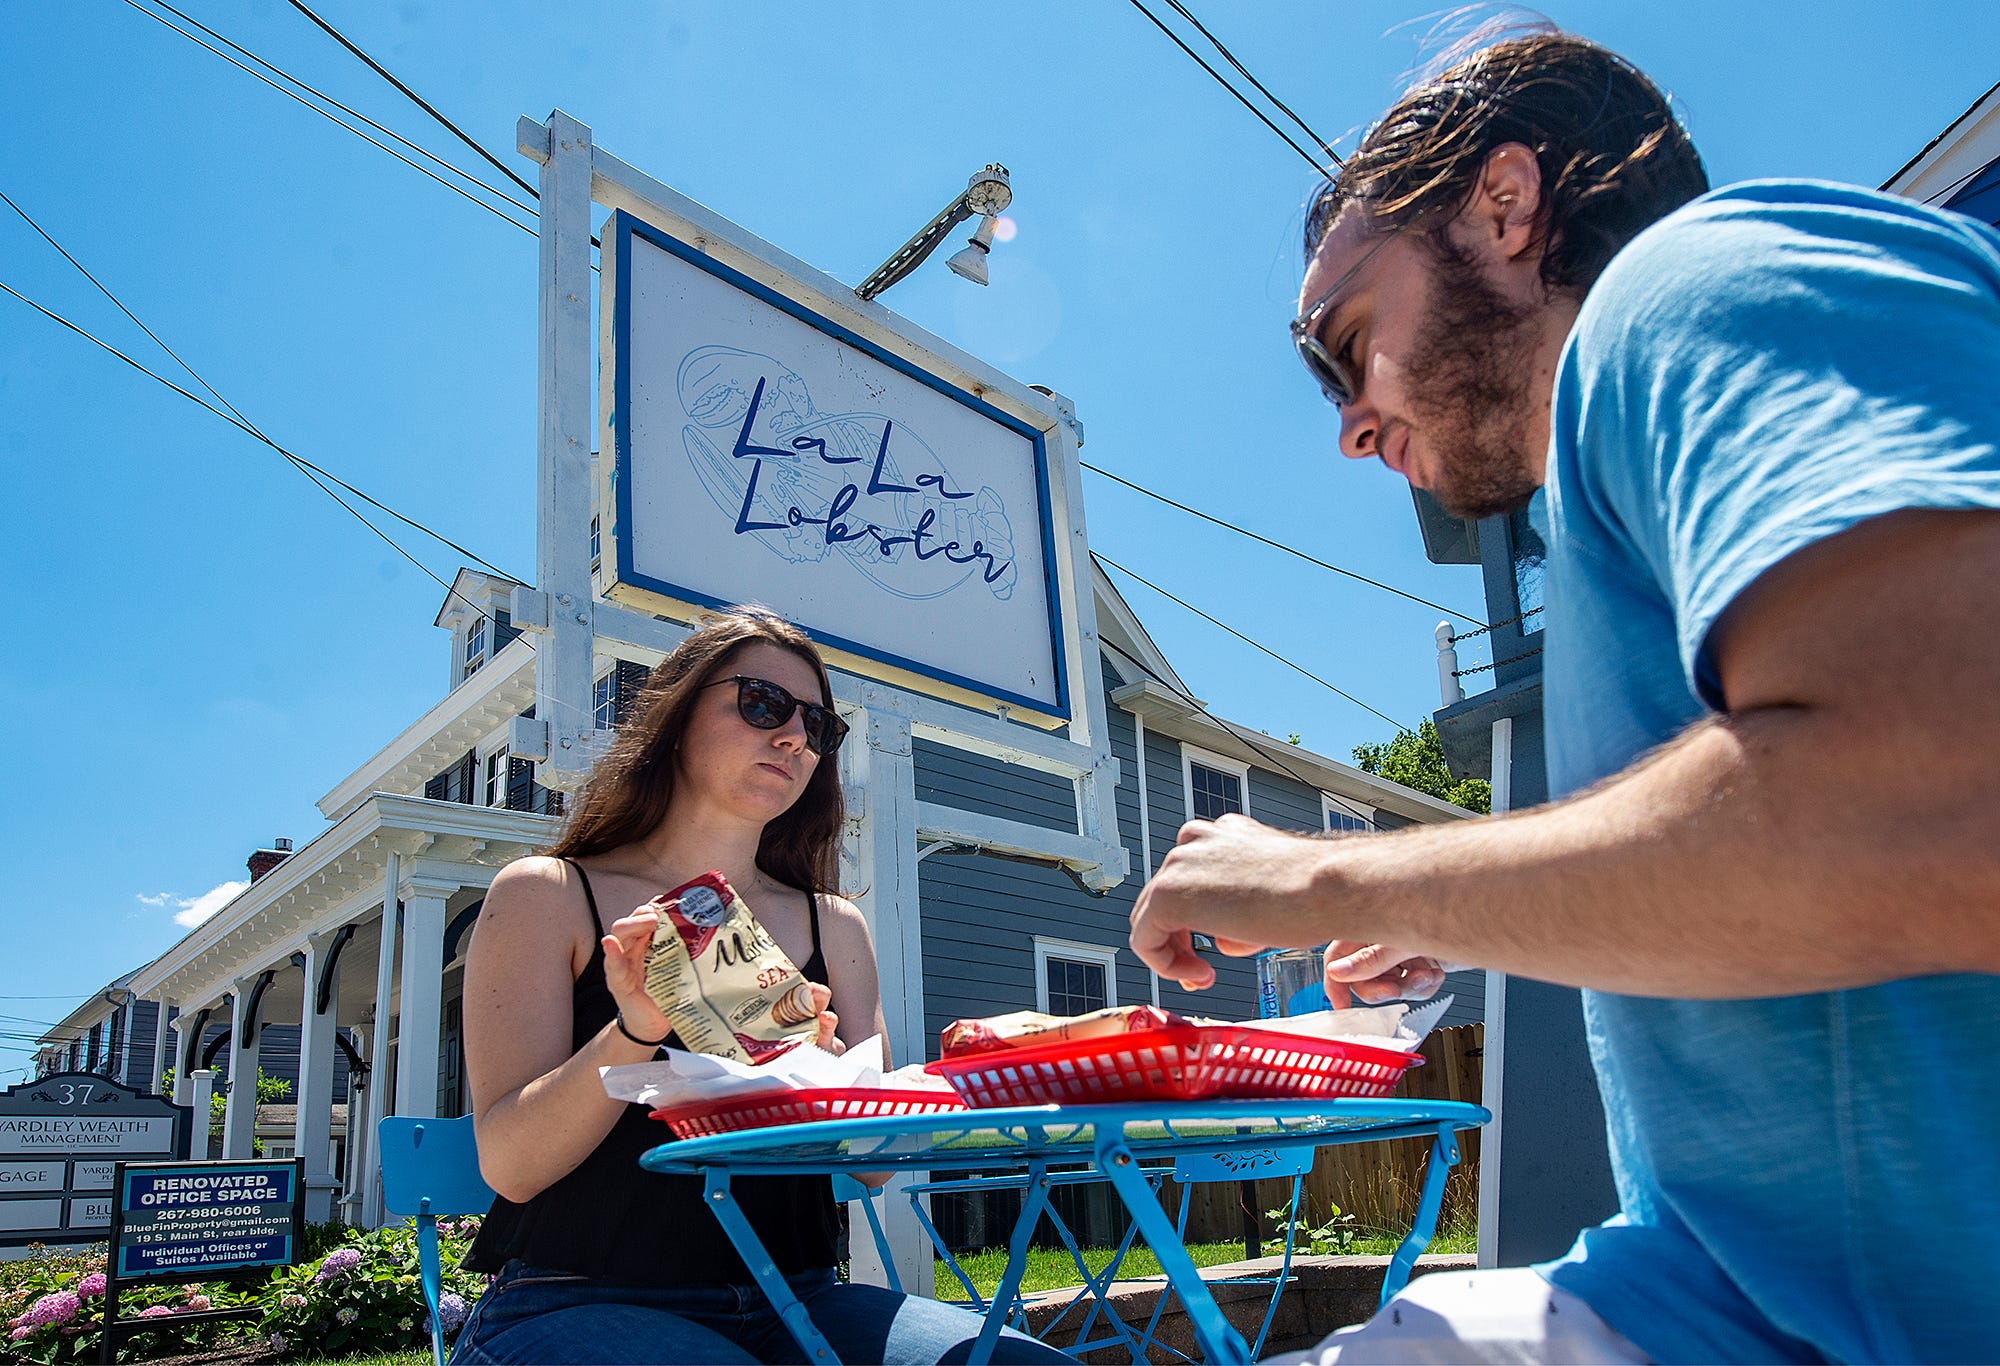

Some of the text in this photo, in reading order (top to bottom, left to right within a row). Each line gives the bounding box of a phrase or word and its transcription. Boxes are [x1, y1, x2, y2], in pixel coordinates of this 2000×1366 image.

[732, 376, 975, 499] La La
[734, 458, 1010, 583] Lobster
[756, 965, 790, 989] SEA
[59, 1084, 94, 1106] 37
[79, 1121, 149, 1132] WEALTH
[21, 1134, 122, 1143] MANAGEMENT
[0, 1170, 48, 1182] GAGE
[153, 1175, 268, 1191] RENOVATED
[141, 1188, 278, 1205] OFFICE SPACE
[86, 1204, 112, 1216] BLU
[157, 1205, 261, 1220] 267-980-6006
[124, 1217, 290, 1233] BlueFinProperty@gmail.com
[136, 1227, 278, 1243] 19 S. Main St, rear bldg.
[142, 1245, 205, 1258] Individual
[208, 1242, 251, 1253] Offices
[156, 1250, 257, 1266] Suites Available
